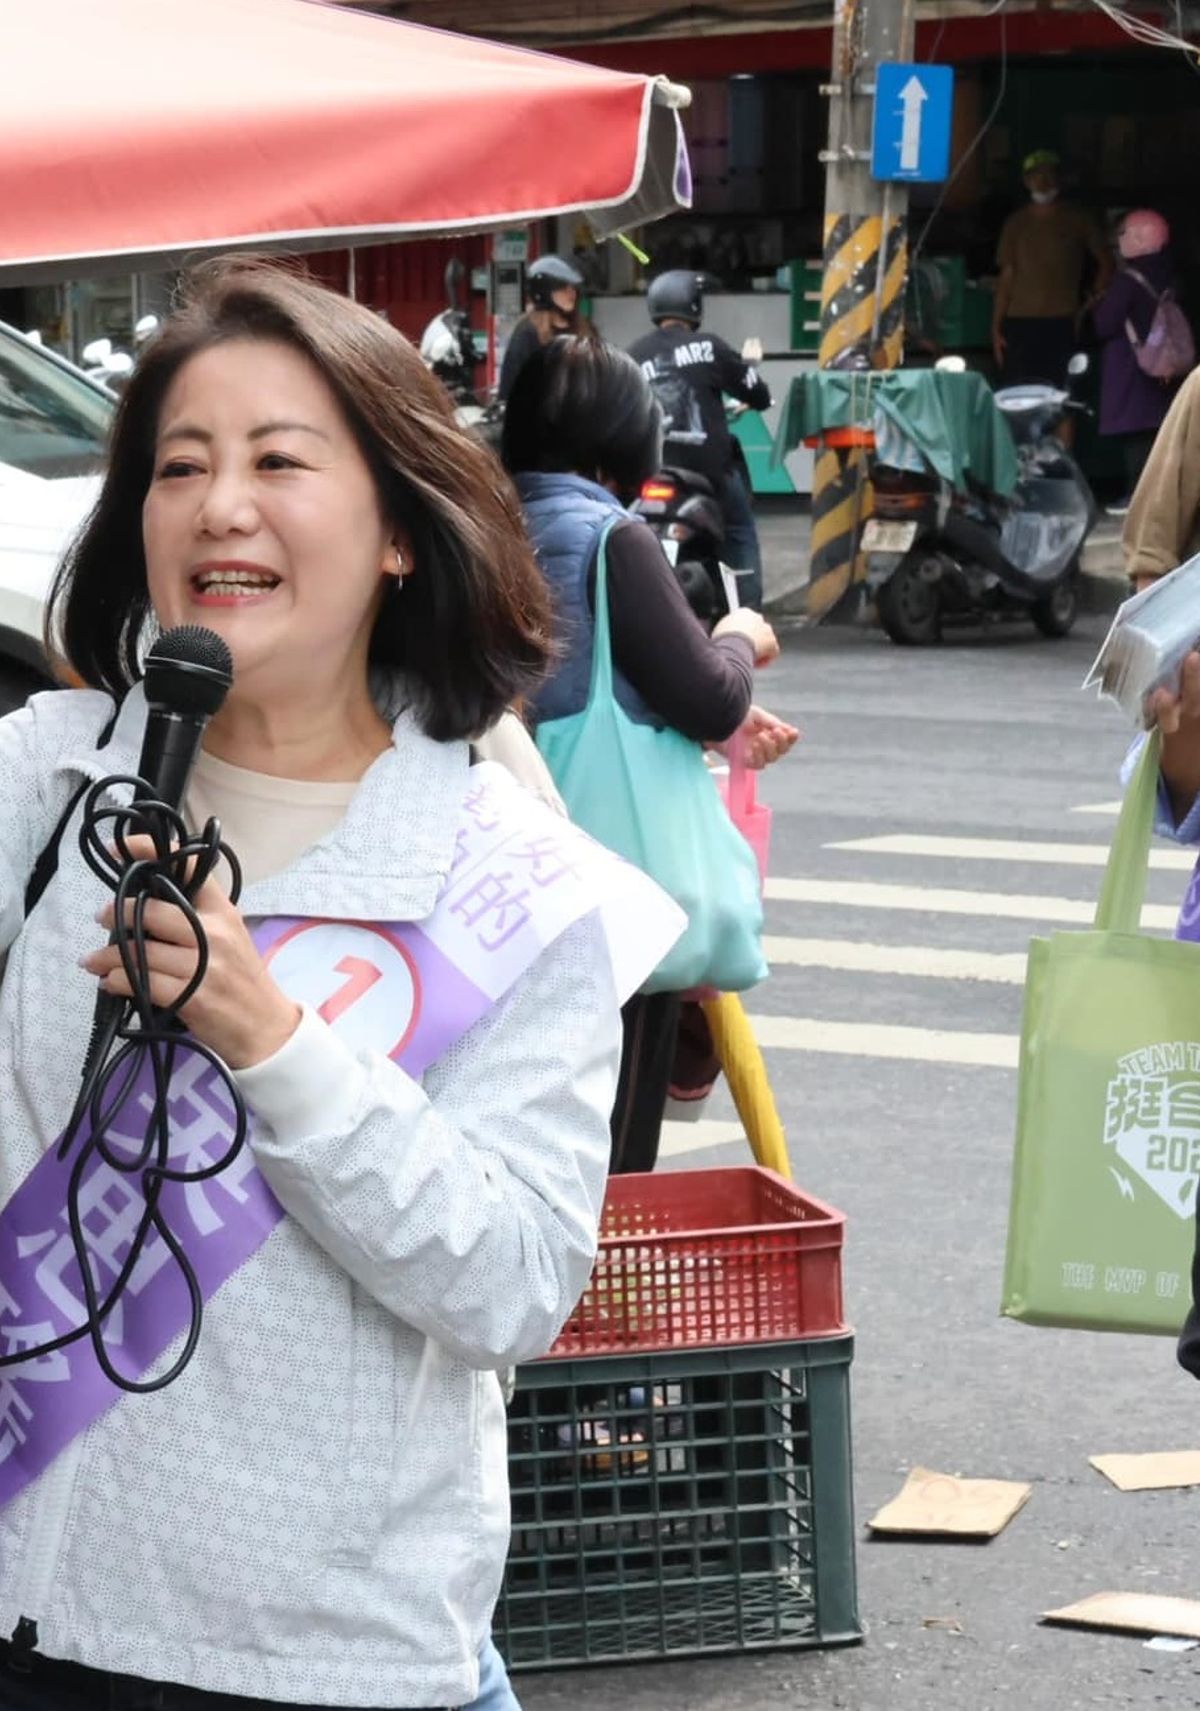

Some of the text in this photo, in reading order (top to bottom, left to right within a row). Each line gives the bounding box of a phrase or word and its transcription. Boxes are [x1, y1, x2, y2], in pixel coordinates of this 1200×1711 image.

[317, 955, 383, 1025] 1
[1117, 1042, 1184, 1077] TEAM
[1104, 1266, 1146, 1294] MVP
[1156, 1271, 1179, 1298] OF
